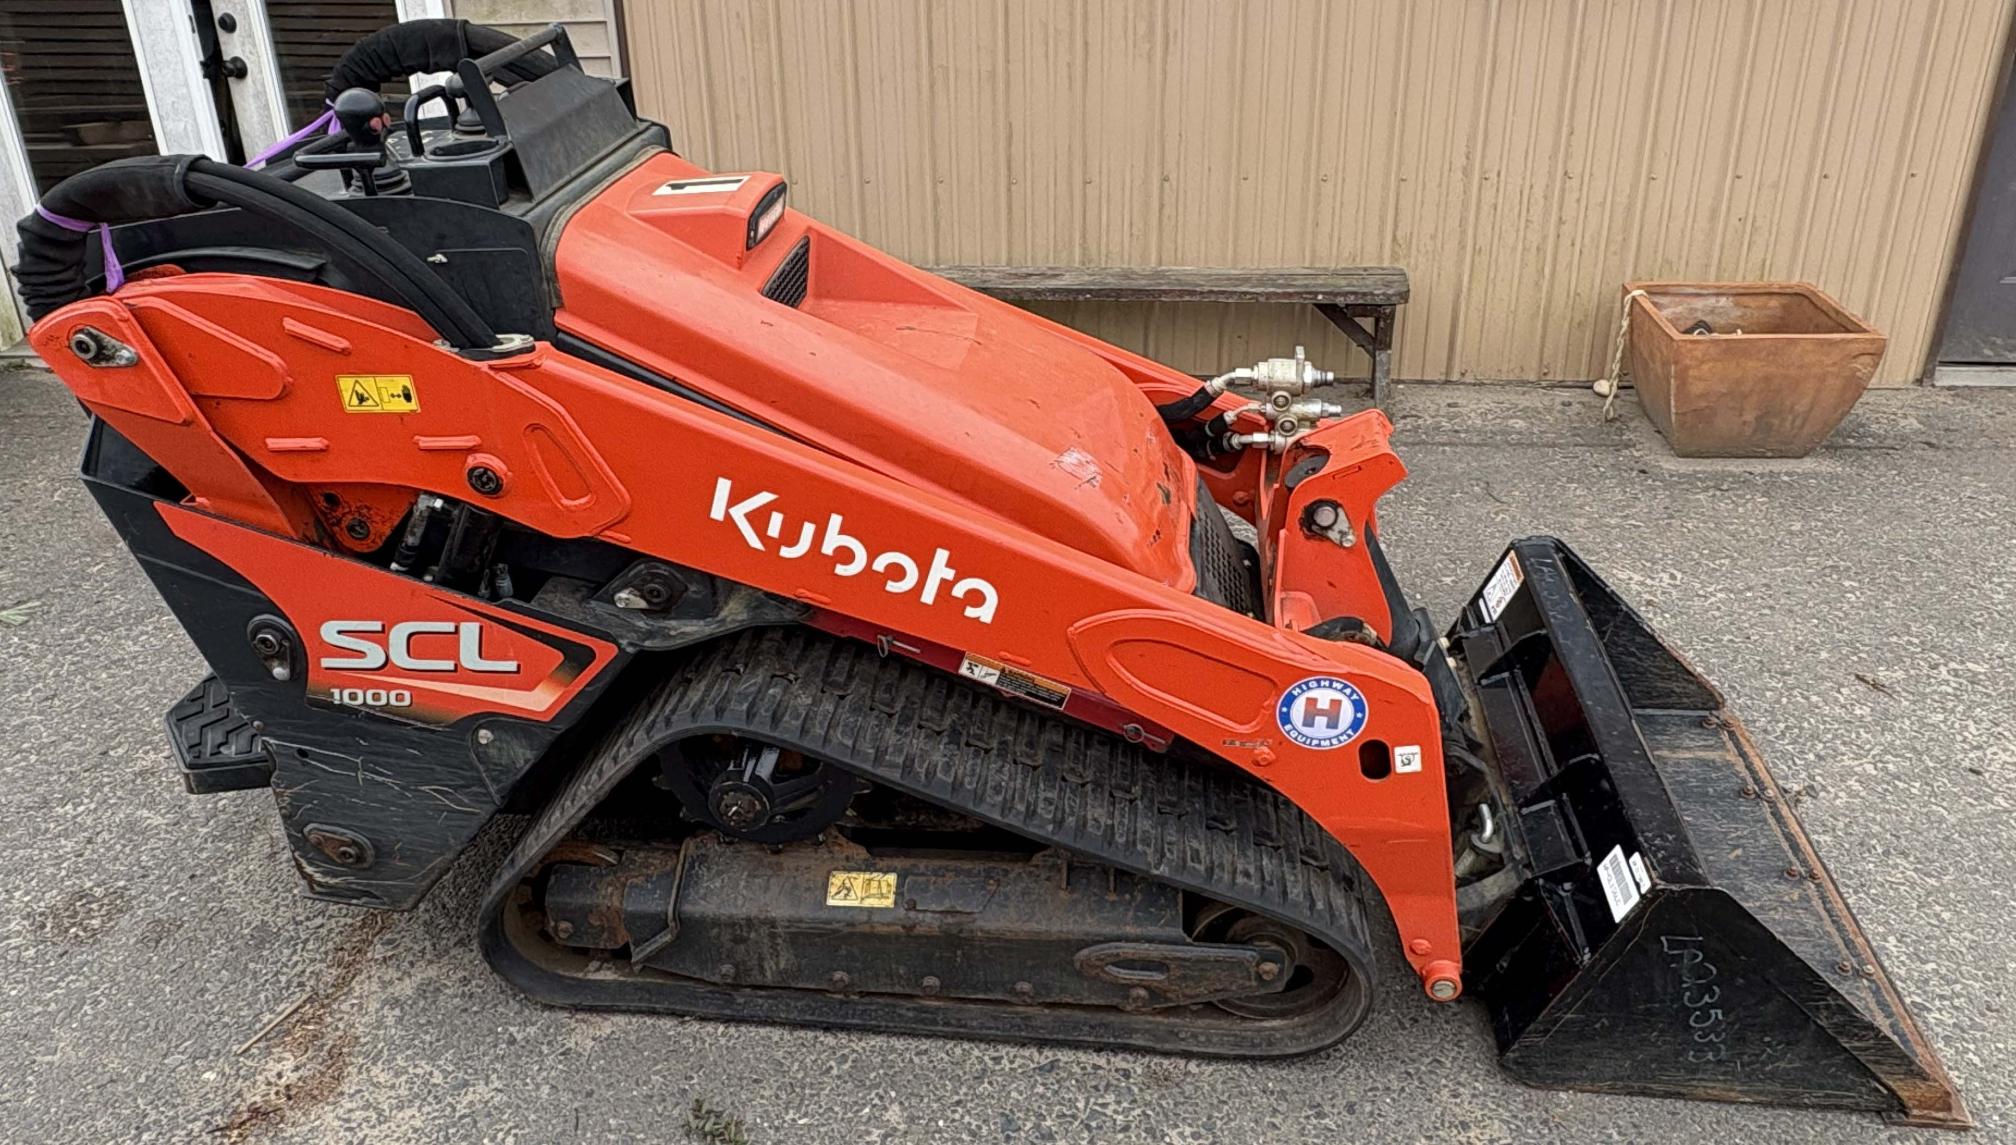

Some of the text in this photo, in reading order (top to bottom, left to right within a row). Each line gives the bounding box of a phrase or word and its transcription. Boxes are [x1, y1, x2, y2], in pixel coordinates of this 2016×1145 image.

[709, 476, 999, 624] Kubota
[319, 620, 519, 673] SCL
[330, 688, 412, 707] 1000
[1291, 679, 1360, 701] HIGHWAY
[1302, 697, 1342, 730] H
[1284, 724, 1355, 747] EQUIPMENT
